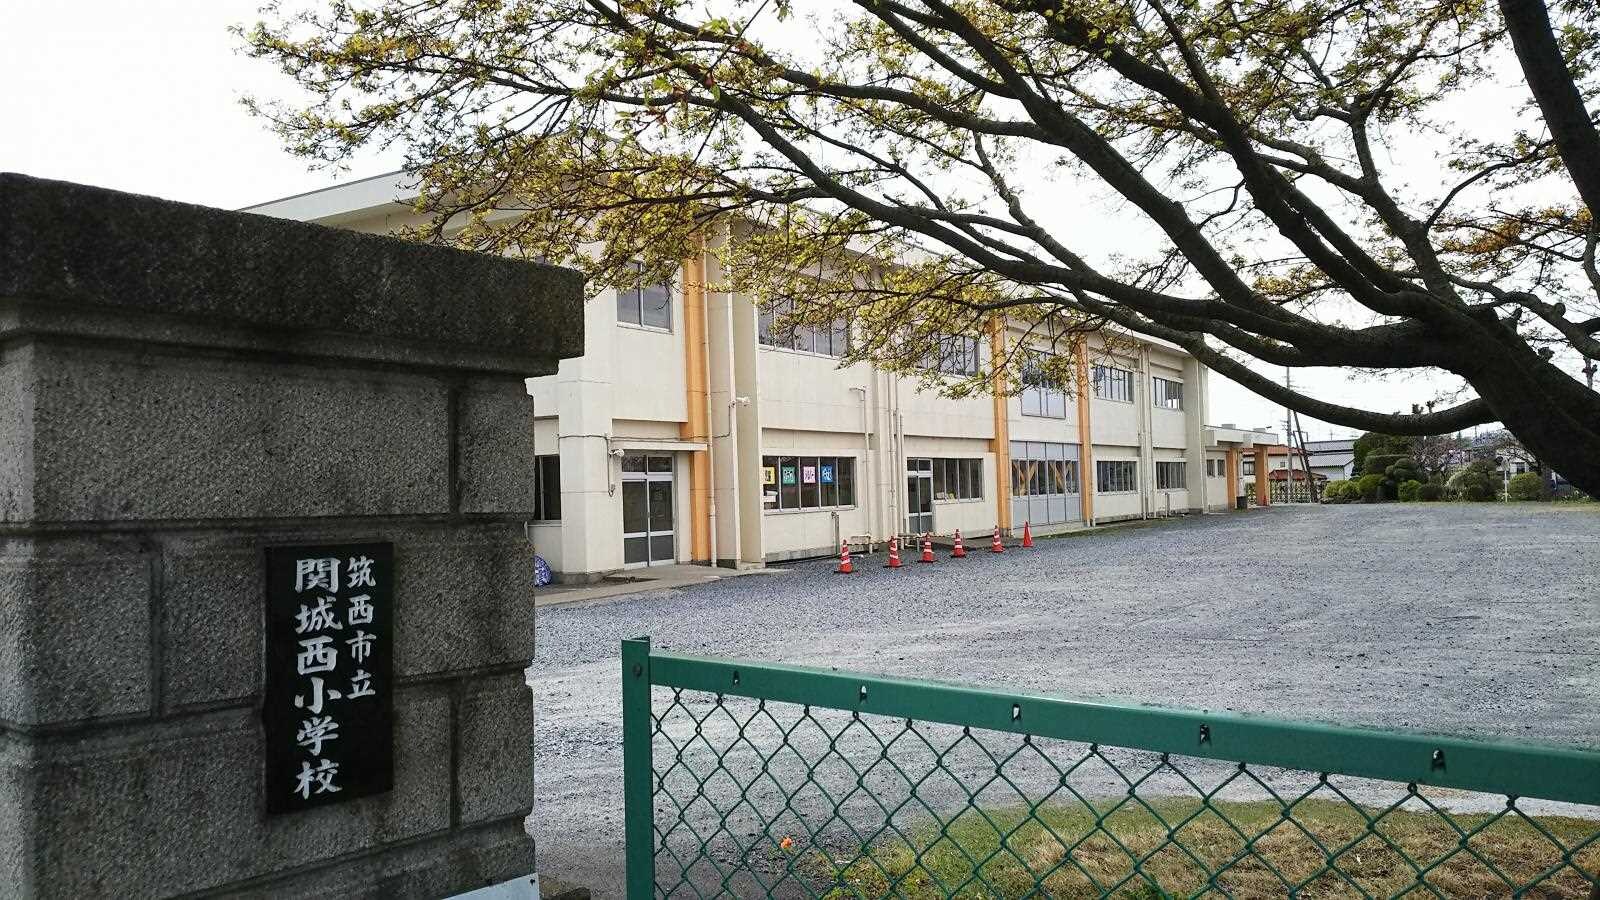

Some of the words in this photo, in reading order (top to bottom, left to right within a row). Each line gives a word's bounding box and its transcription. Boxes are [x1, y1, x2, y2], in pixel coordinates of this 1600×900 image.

[294, 557, 343, 799] 関城西小学校
[346, 556, 376, 699] 筑西市立
